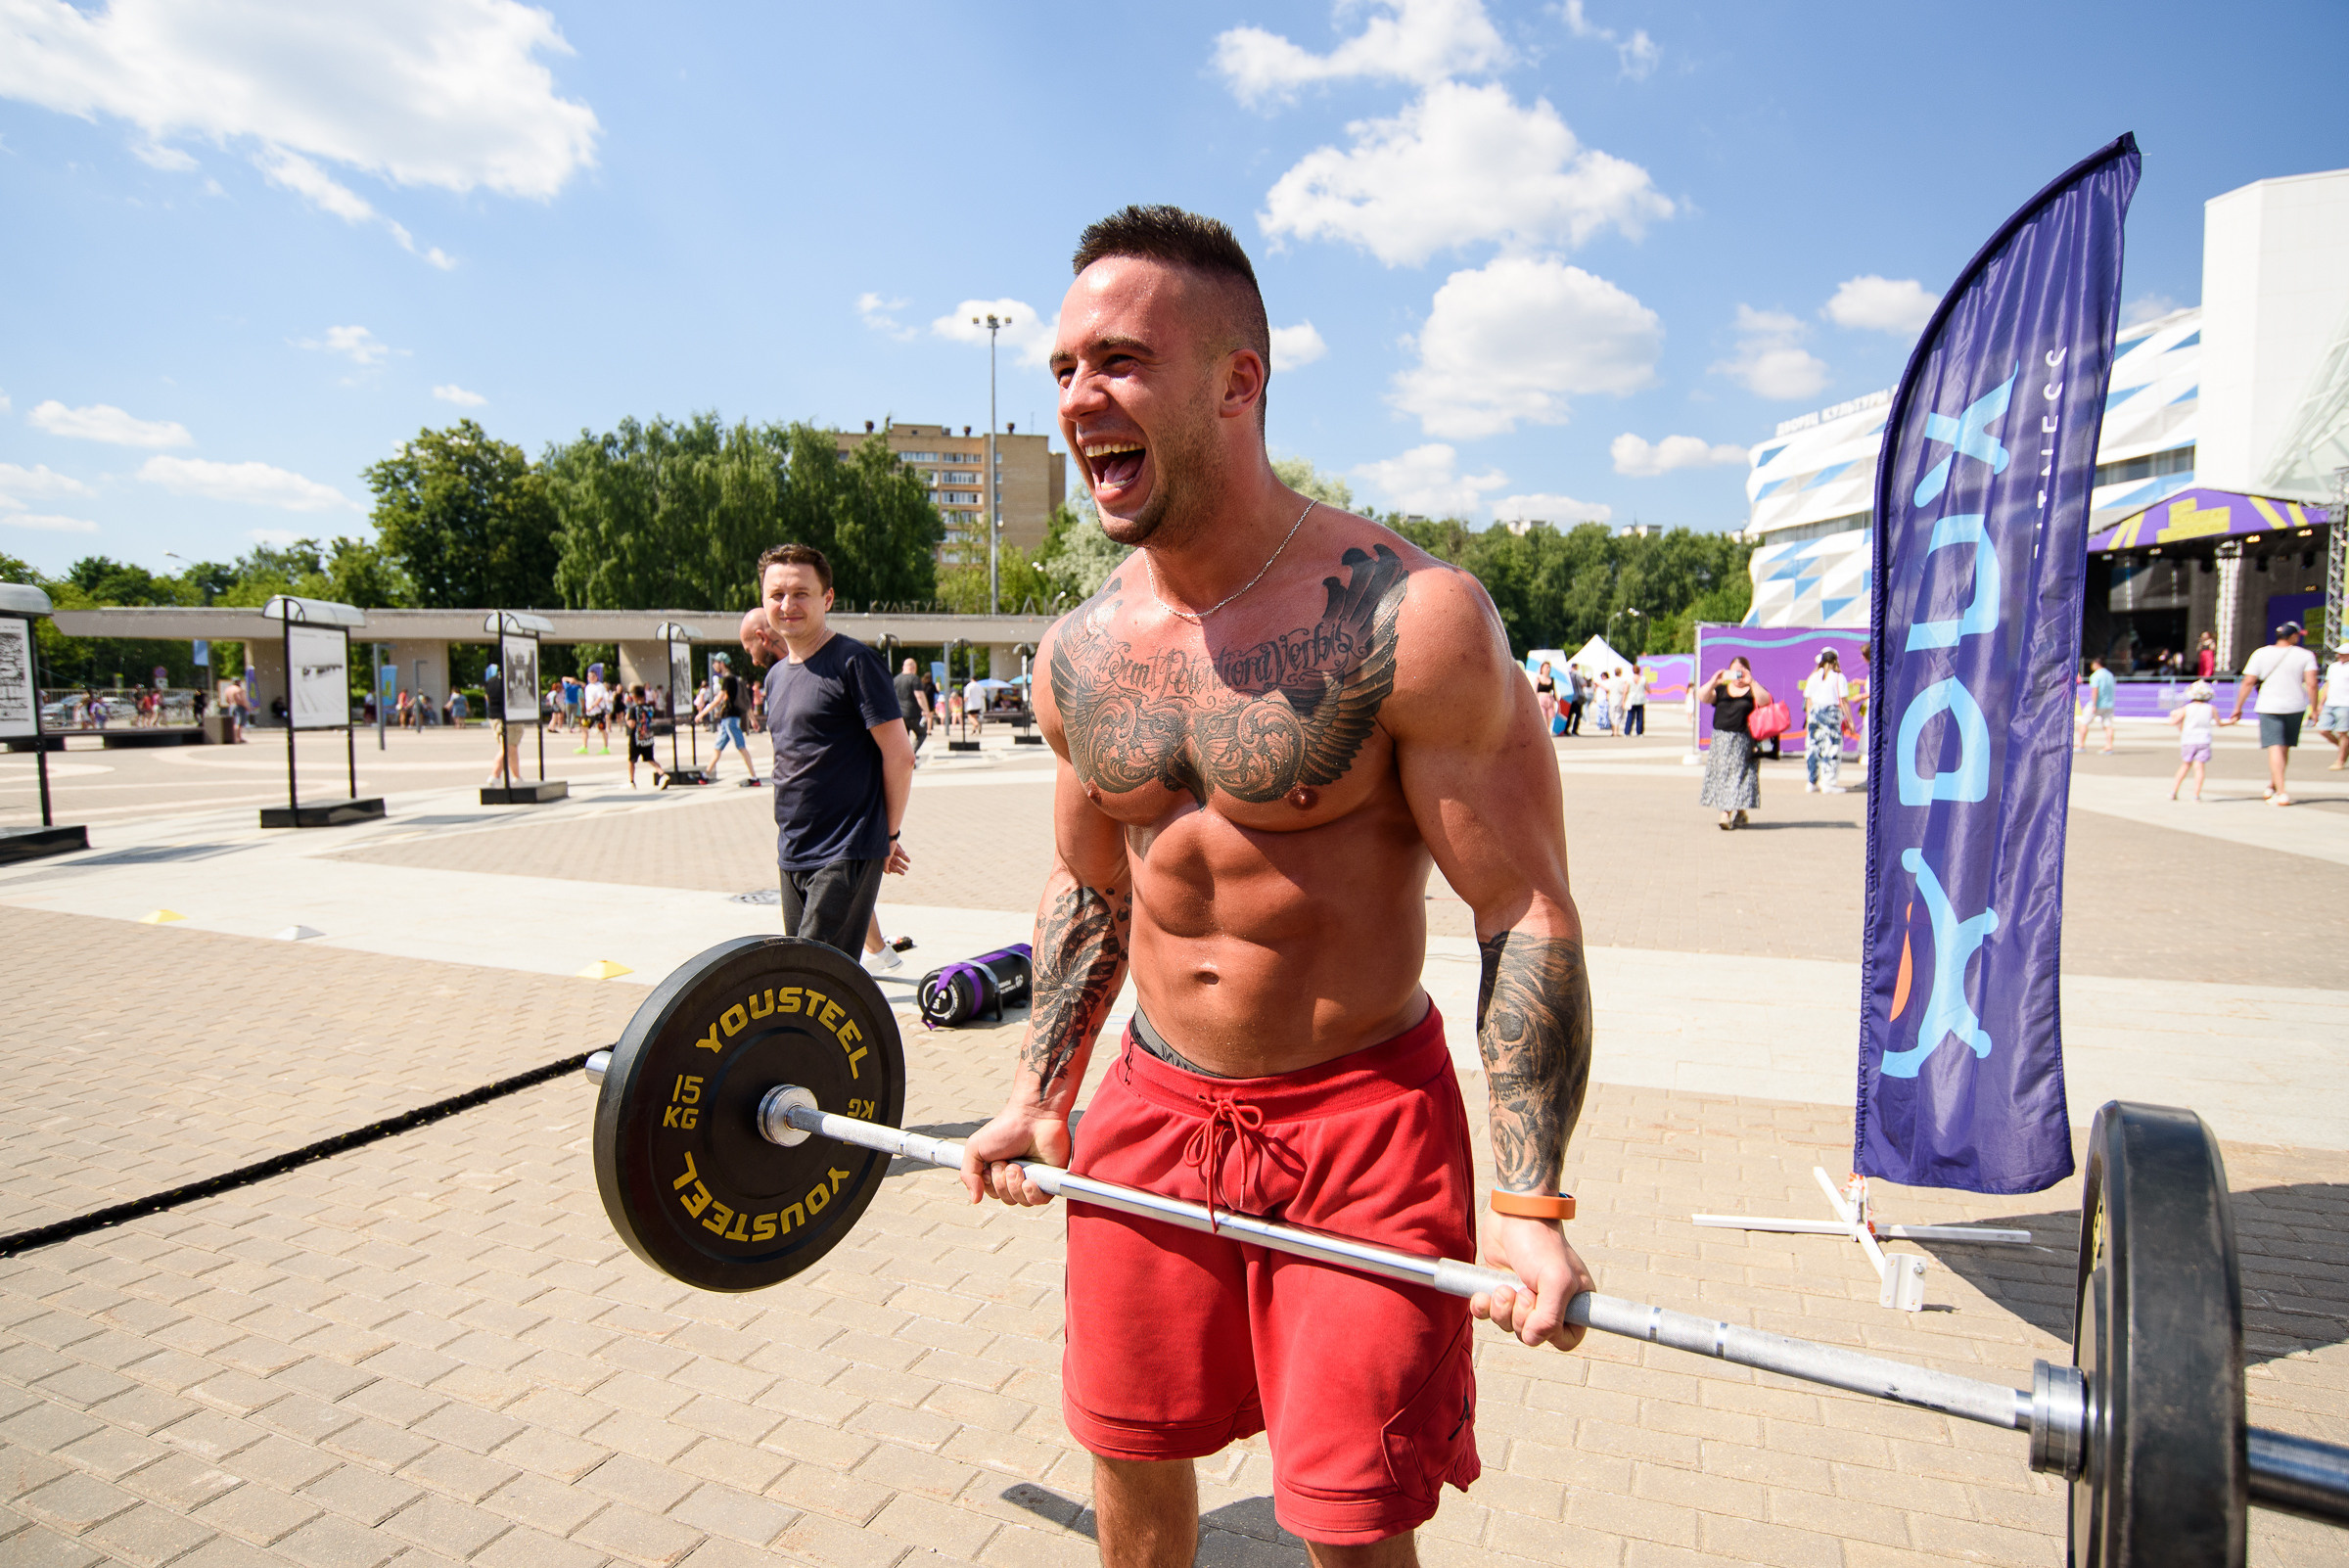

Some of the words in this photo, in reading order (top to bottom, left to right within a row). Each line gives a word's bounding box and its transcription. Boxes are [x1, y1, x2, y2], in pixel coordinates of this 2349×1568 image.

[1820, 389, 1889, 423] КУЛЬТУРЫ
[869, 599, 959, 614] КУЛЬТУРЫ
[1260, 618, 1355, 685] Verbis
[695, 987, 868, 1080] YOUSTEEL
[672, 1075, 704, 1104] 15
[663, 1106, 699, 1130] KG
[847, 1098, 876, 1120] KG
[672, 1151, 851, 1242] YOUSTEEL
